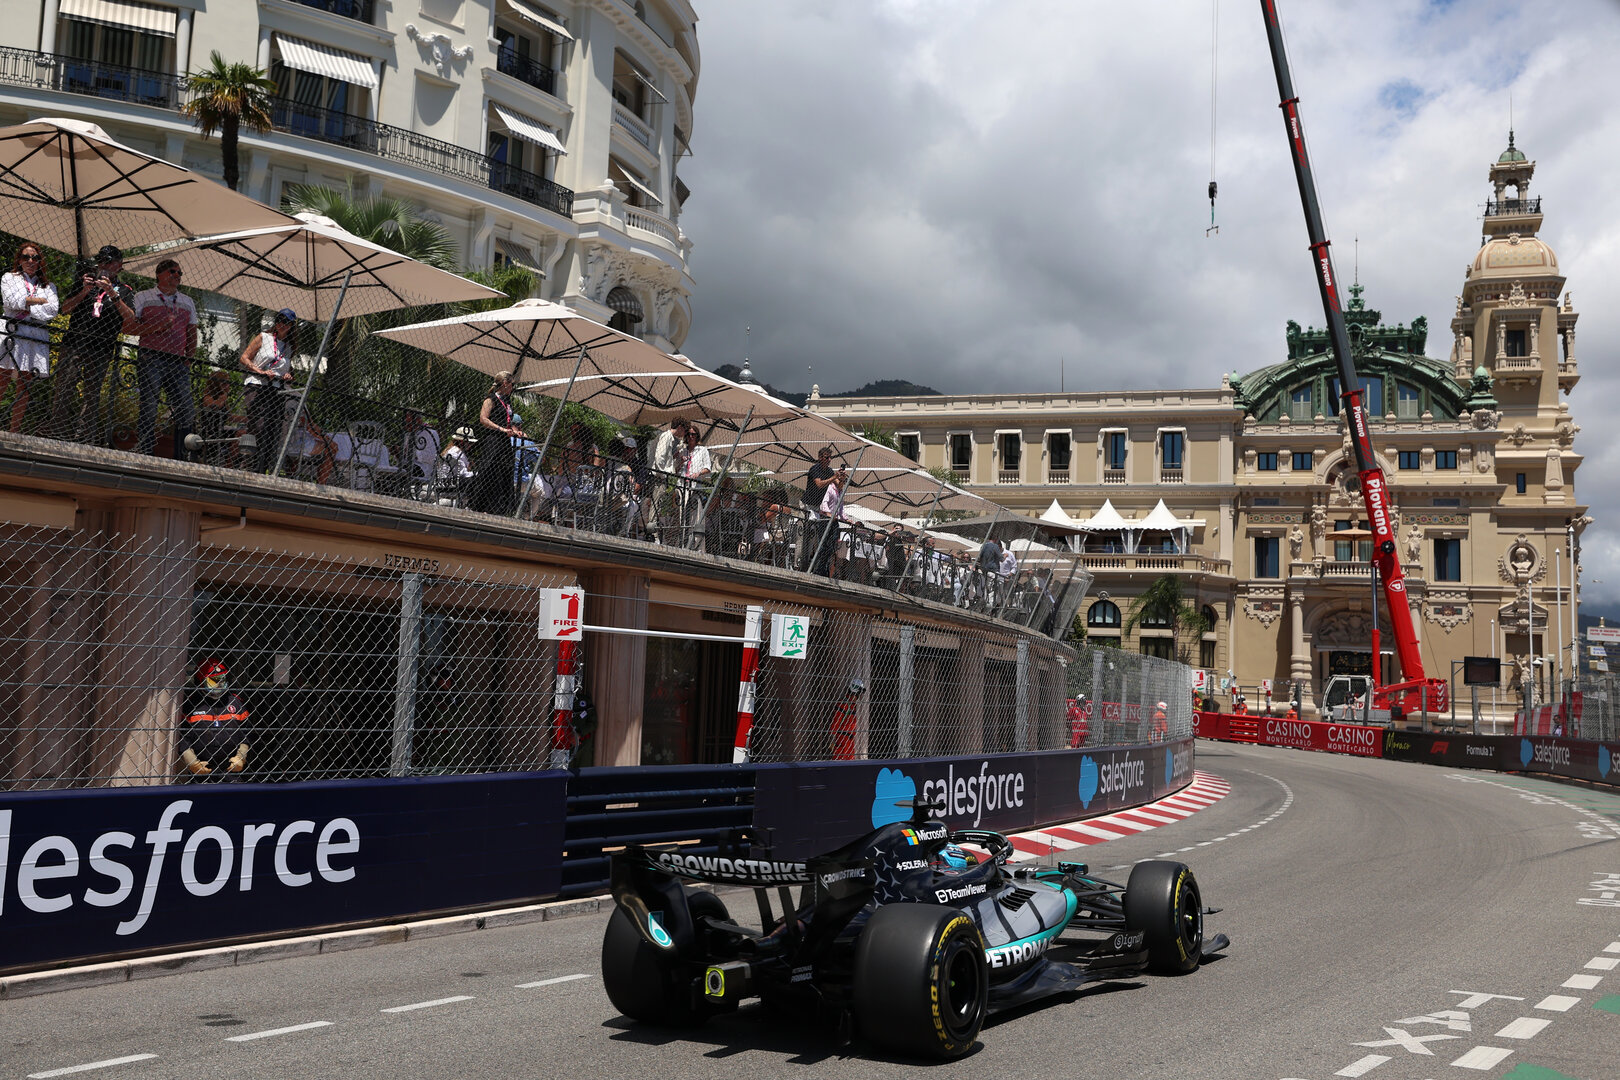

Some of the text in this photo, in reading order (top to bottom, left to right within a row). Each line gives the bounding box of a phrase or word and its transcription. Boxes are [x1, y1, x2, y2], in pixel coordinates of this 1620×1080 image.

[1321, 258, 1331, 286] Piovano
[1353, 406, 1365, 437] Piovano
[1367, 479, 1388, 535] Piovano
[1266, 720, 1312, 739] CASINO
[1327, 726, 1375, 746] CASINO
[1466, 744, 1489, 756] Formula
[1534, 739, 1570, 770] salesforce
[1100, 751, 1145, 801] salesforce
[923, 761, 1025, 829] salesforce
[915, 826, 948, 841] Microsoft
[659, 853, 811, 881] CROWDSTRIKE
[823, 867, 866, 884] CROWDSTRIKE
[901, 860, 928, 870] SOLERA
[946, 884, 987, 900] TeamViewer
[1279, 990, 1526, 1080] TAXI
